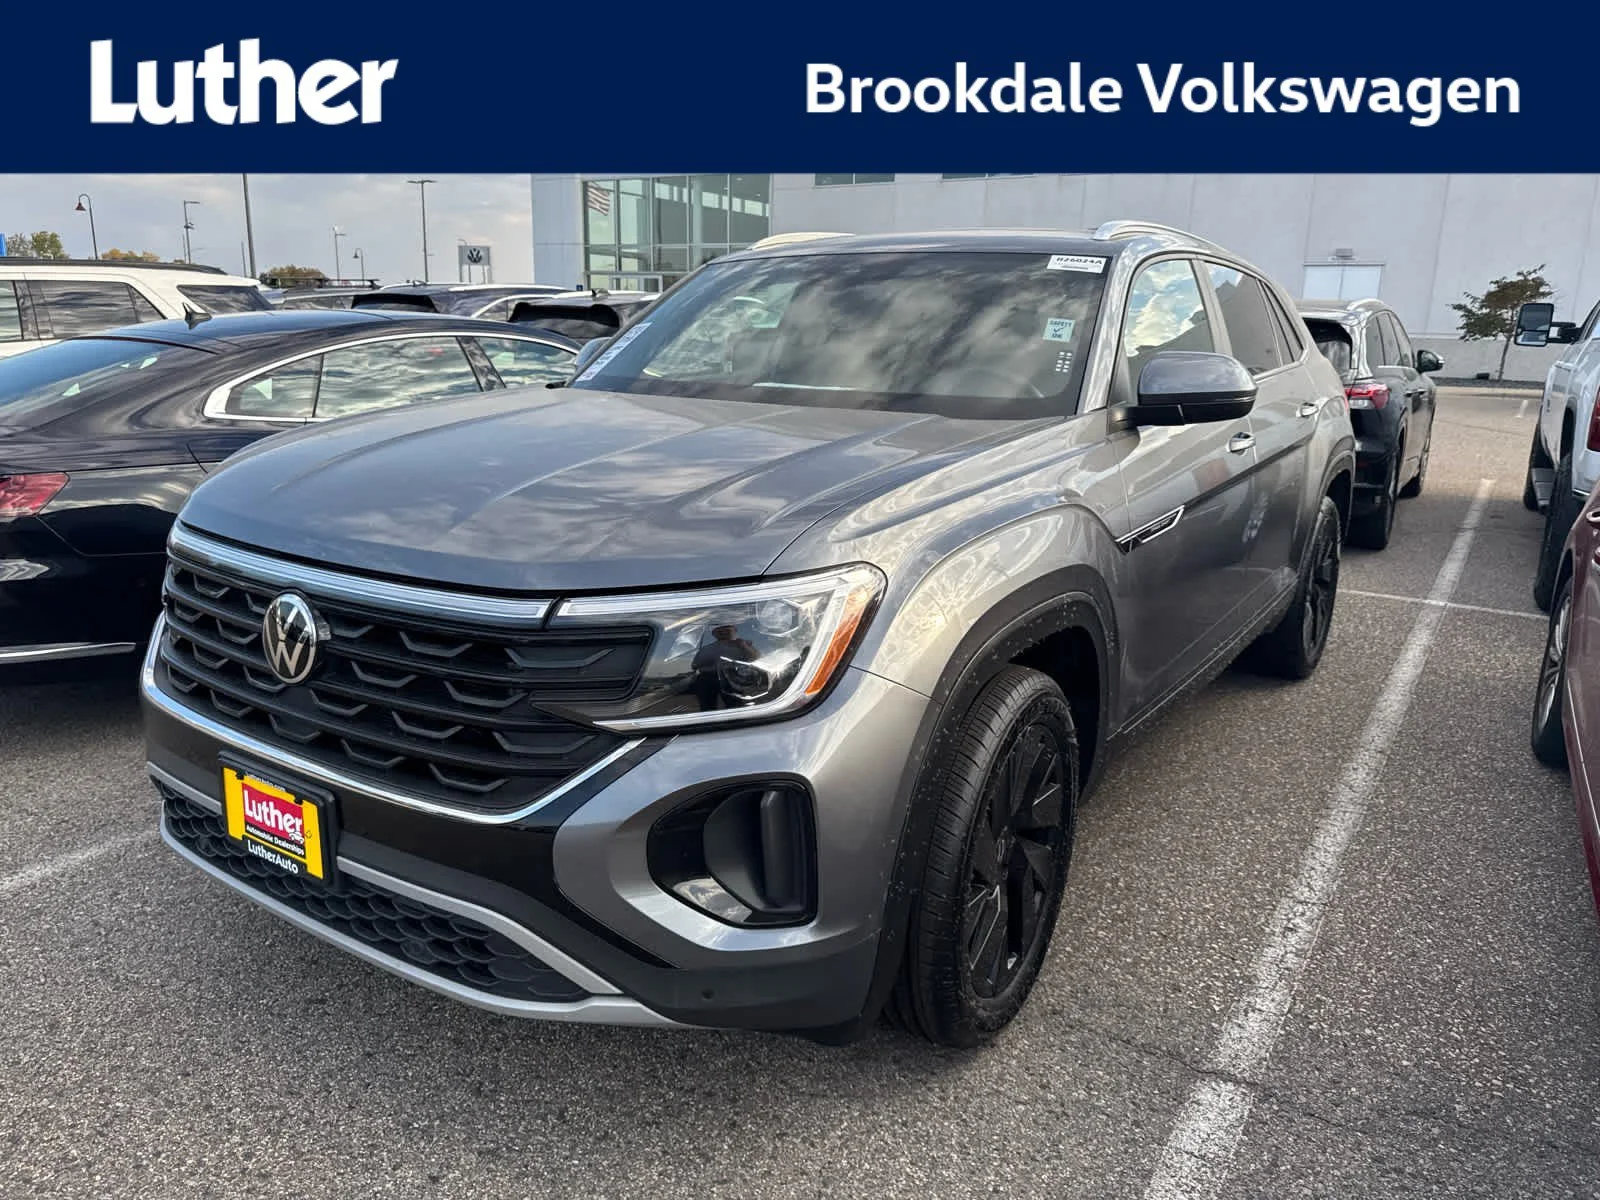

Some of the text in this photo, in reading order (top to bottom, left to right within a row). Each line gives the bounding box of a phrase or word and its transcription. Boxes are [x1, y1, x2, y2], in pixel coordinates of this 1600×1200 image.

[264, 594, 316, 683] VW
[244, 790, 302, 833] Luther
[247, 840, 298, 874] LutherAuto
